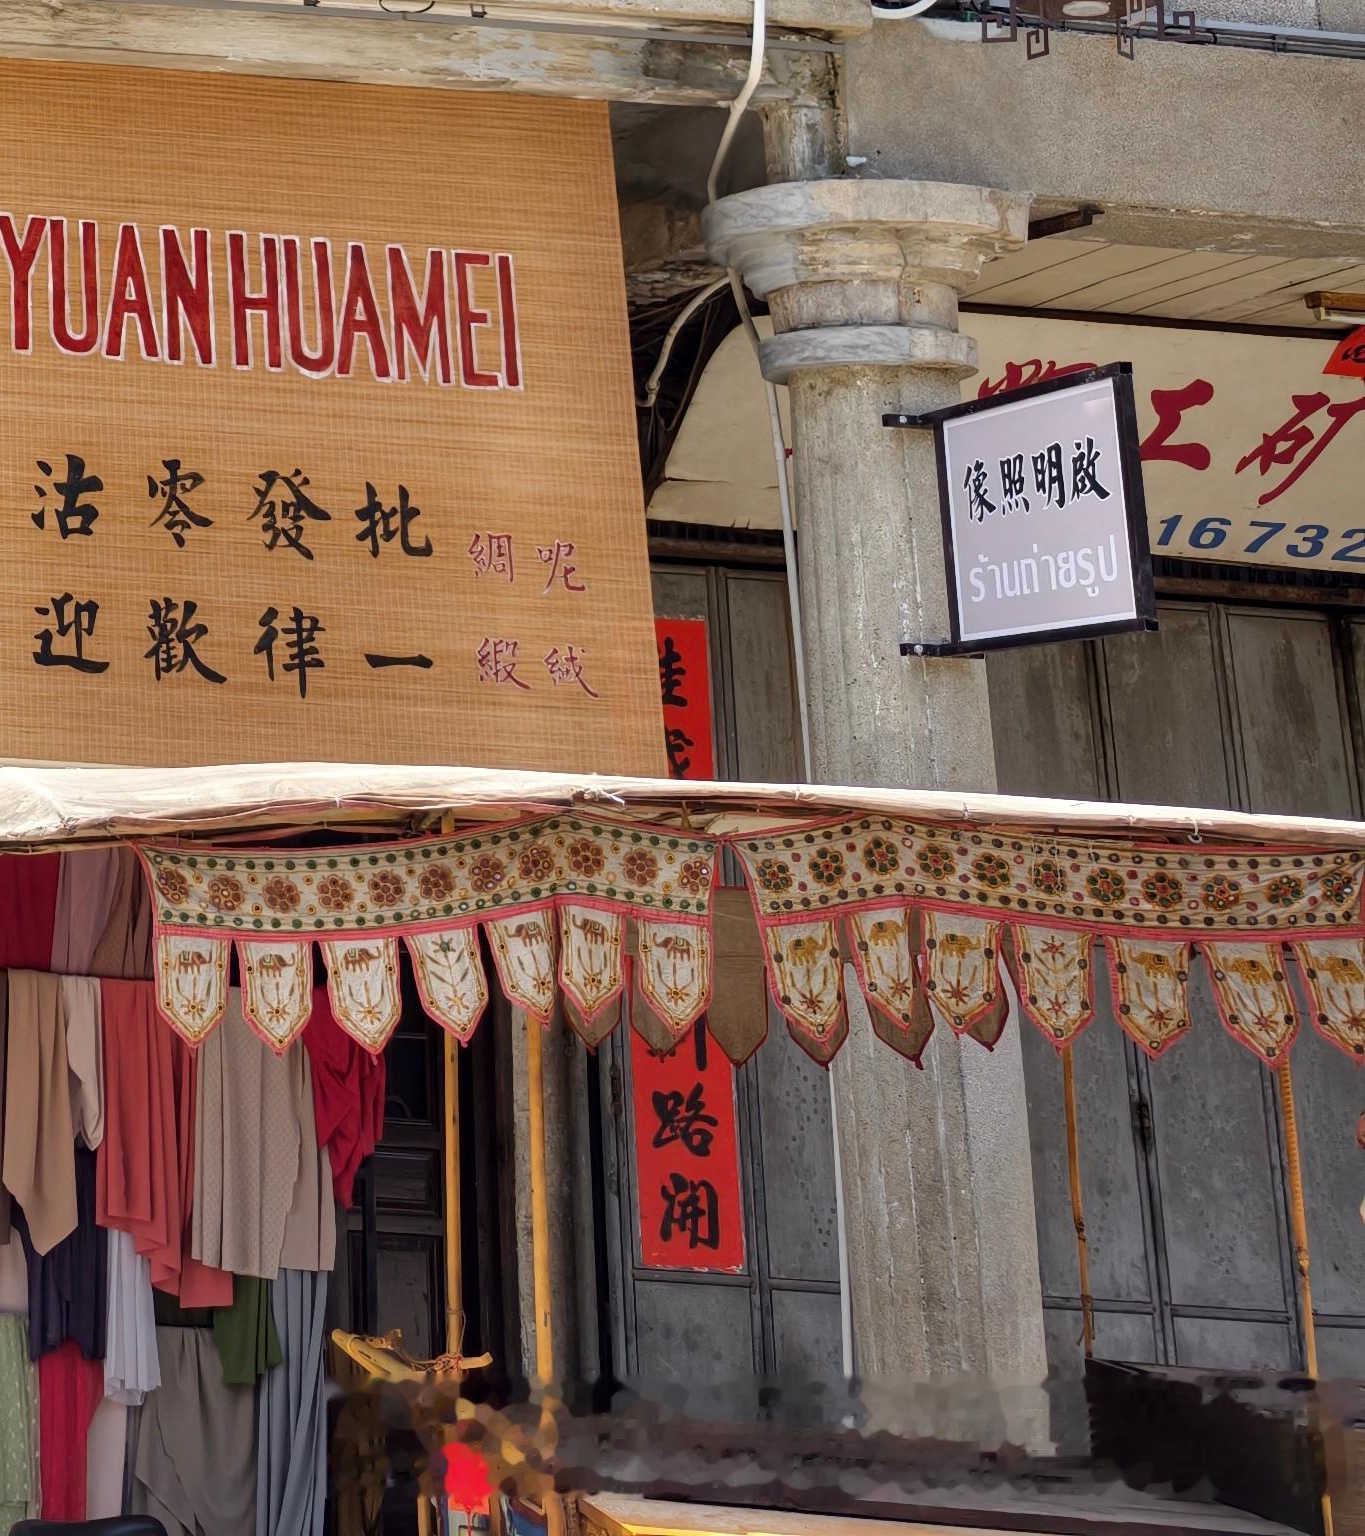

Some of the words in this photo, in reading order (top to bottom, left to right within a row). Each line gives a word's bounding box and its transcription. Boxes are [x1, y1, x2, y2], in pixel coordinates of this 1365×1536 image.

[969, 534, 1118, 603] ร้านถ่ายรูป
